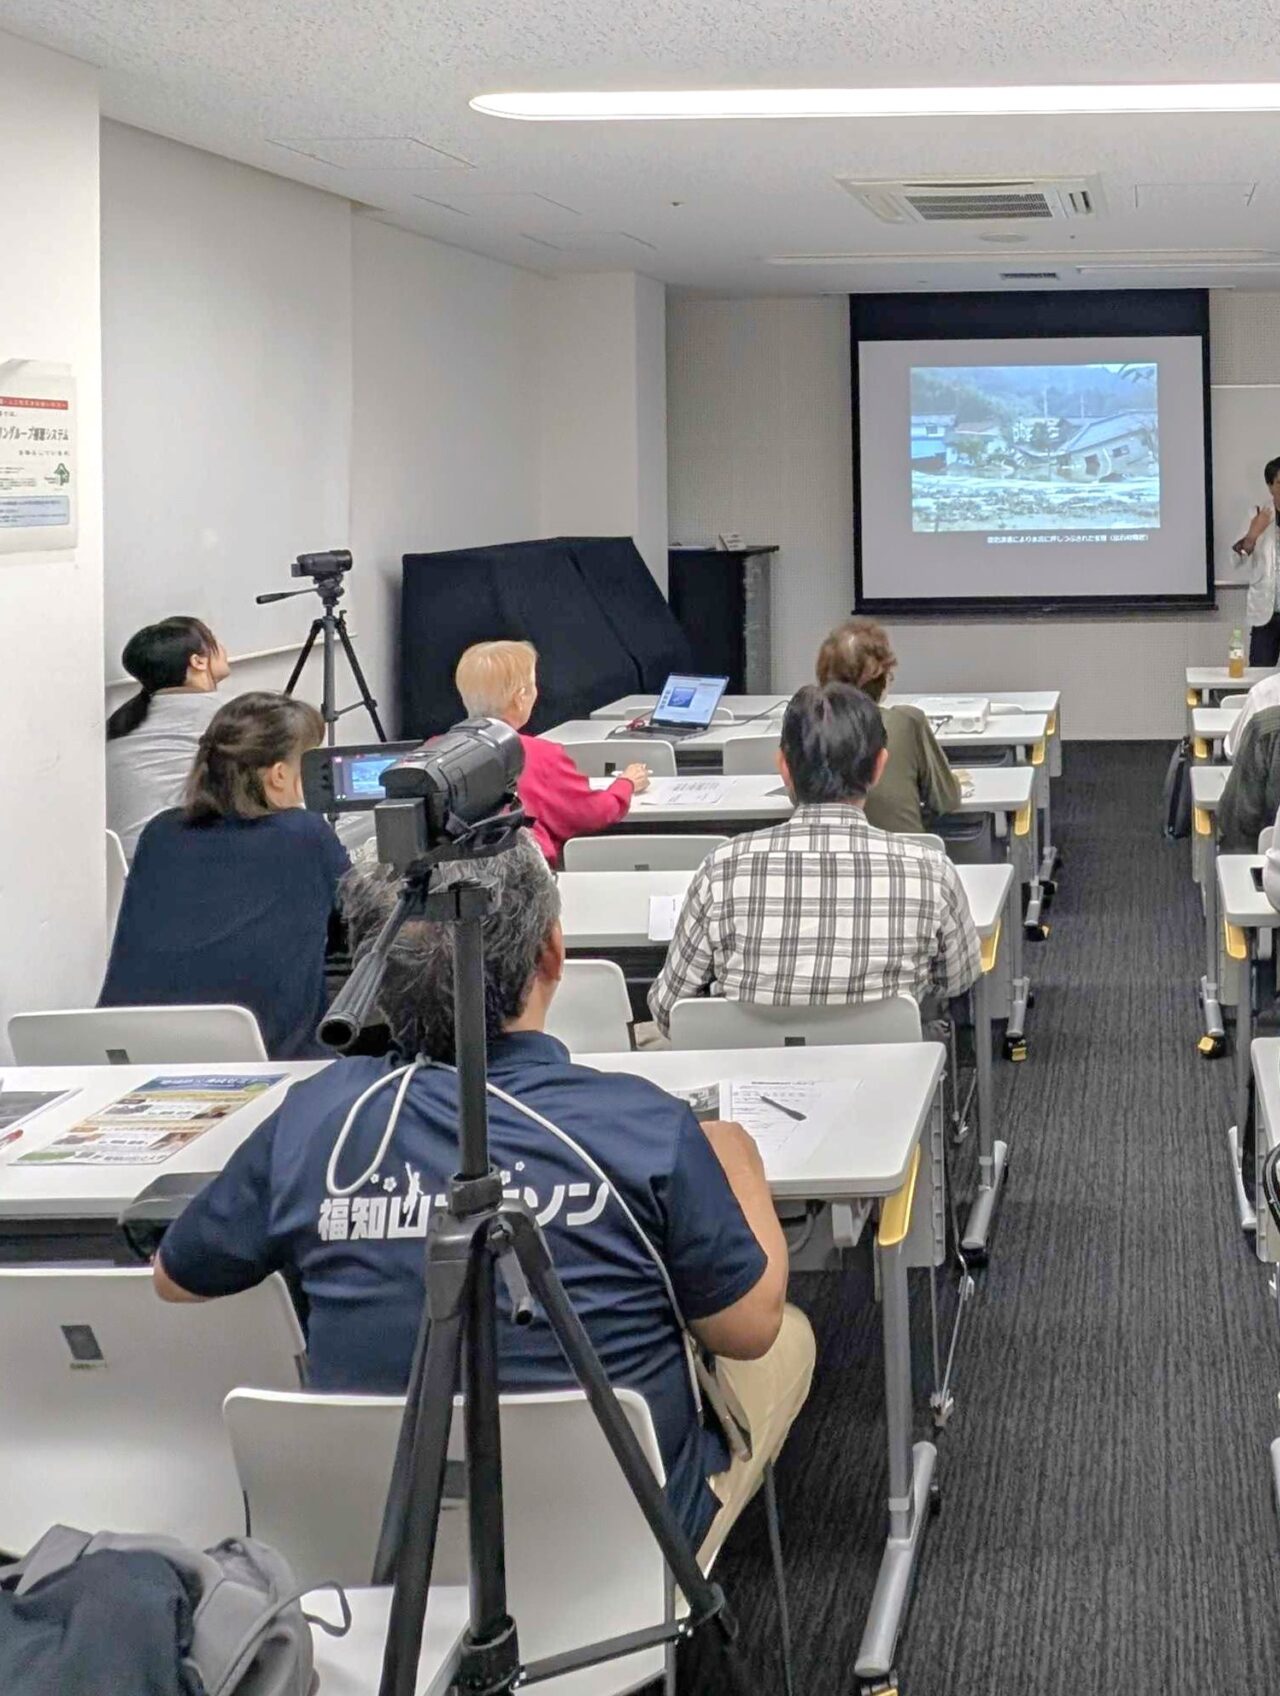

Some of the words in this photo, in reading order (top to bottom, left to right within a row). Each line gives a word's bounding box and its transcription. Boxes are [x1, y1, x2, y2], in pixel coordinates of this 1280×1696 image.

[318, 1182, 609, 1241] 福知山ソン
